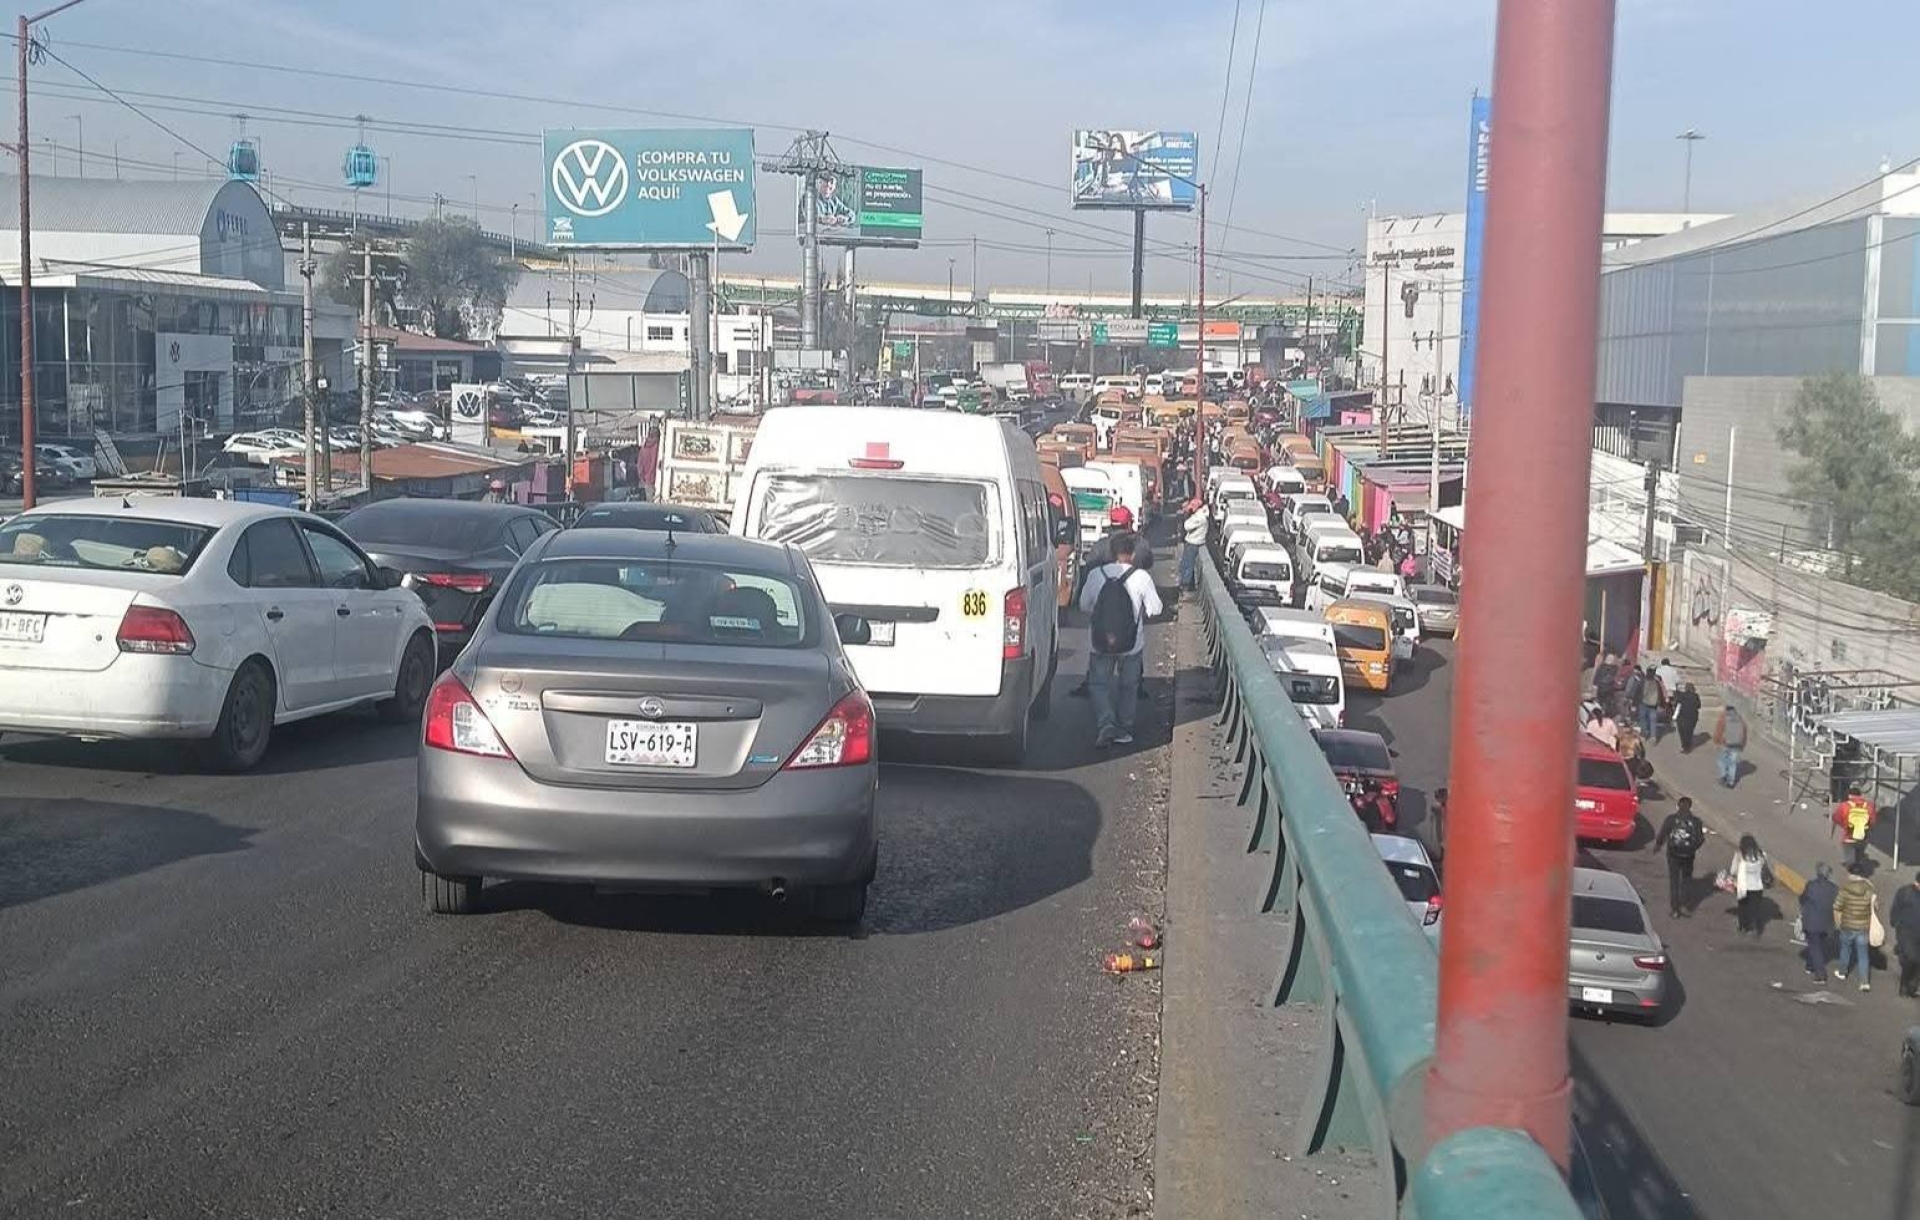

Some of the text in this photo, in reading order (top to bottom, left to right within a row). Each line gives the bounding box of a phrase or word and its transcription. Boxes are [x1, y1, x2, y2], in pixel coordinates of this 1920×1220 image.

[637, 151, 730, 167] ¡COMPRA TU
[638, 168, 744, 183] VOLKSWAGEN
[638, 184, 680, 199] AQUÍ!
[964, 592, 986, 616] 836
[609, 731, 692, 752] LSV-619-A
